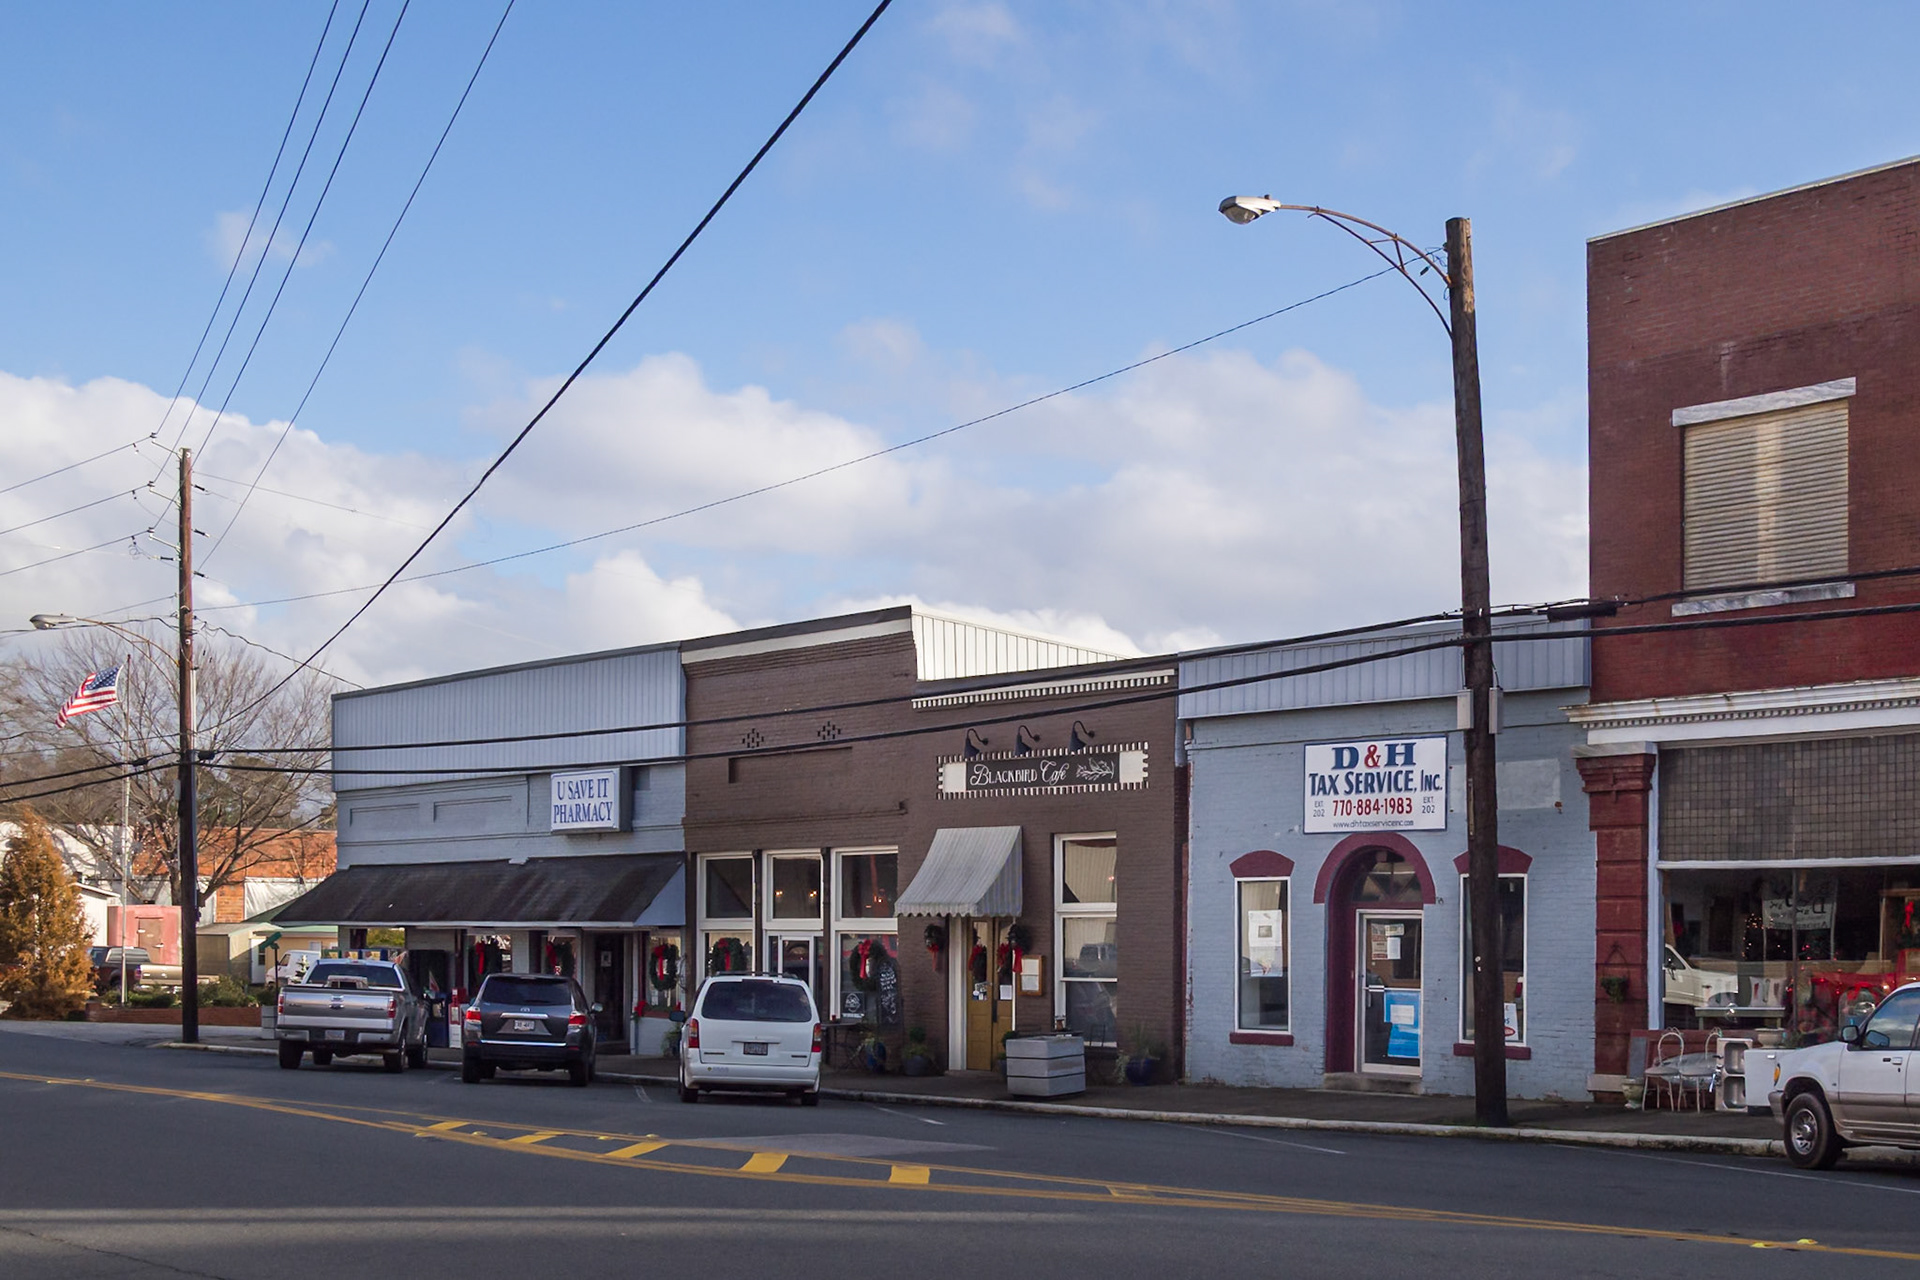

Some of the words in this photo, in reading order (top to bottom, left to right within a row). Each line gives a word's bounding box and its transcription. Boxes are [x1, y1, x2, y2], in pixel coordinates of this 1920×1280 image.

[1331, 746, 1359, 770] D
[1364, 744, 1381, 768] &
[1384, 742, 1417, 767] H
[557, 781, 565, 800] U
[568, 778, 594, 800] SAVE
[597, 777, 609, 798] IT
[1308, 772, 1340, 796] TAX
[553, 801, 613, 824] PHARMACY
[1313, 808, 1325, 818] 202
[1332, 797, 1413, 816] 770-884-1983
[1421, 804, 1435, 814] 202
